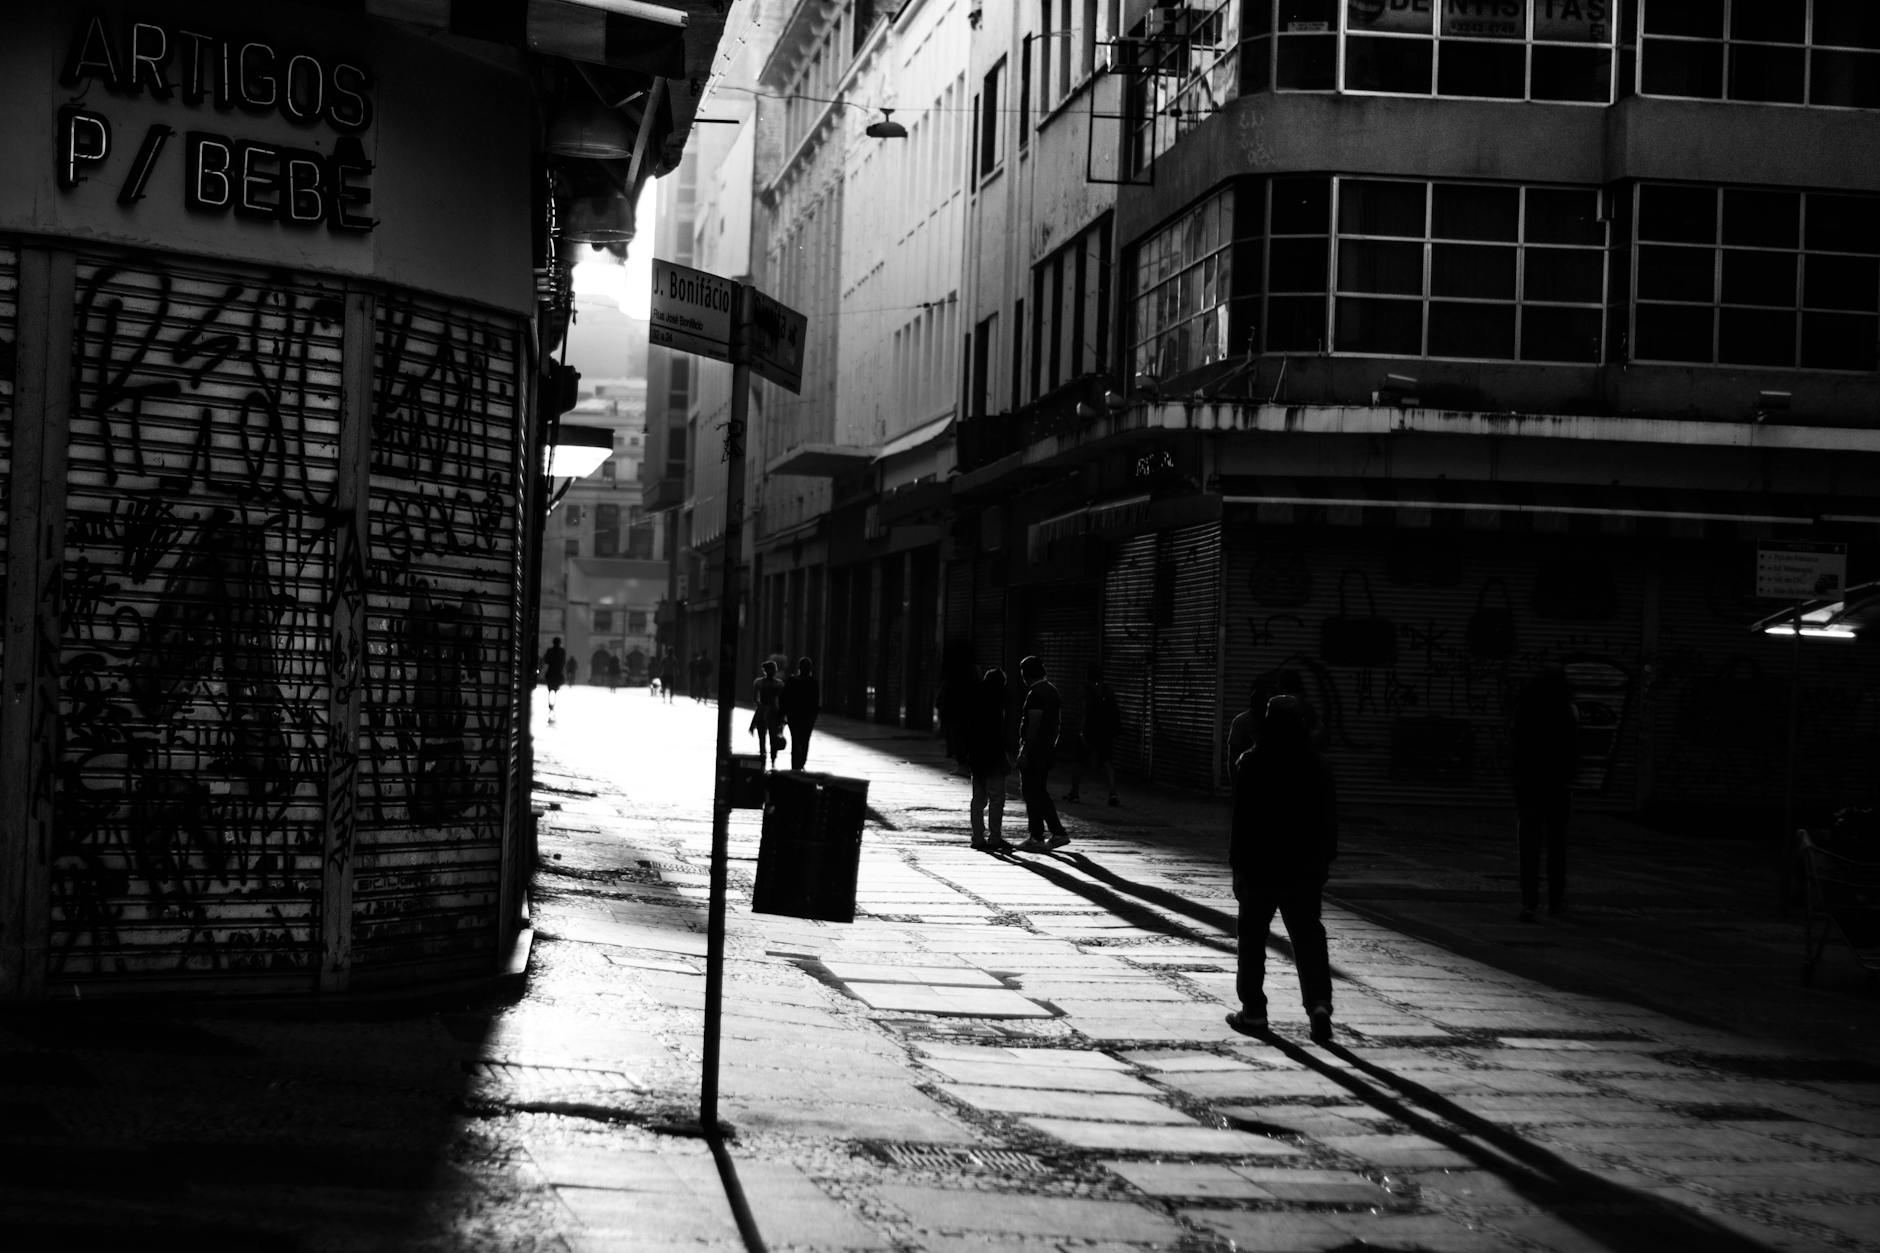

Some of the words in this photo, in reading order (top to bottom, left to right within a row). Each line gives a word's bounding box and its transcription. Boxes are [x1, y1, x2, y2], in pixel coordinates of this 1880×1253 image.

[60, 10, 374, 132] ARTIGOS
[653, 266, 664, 296] J.
[670, 271, 729, 314] Bonifácio
